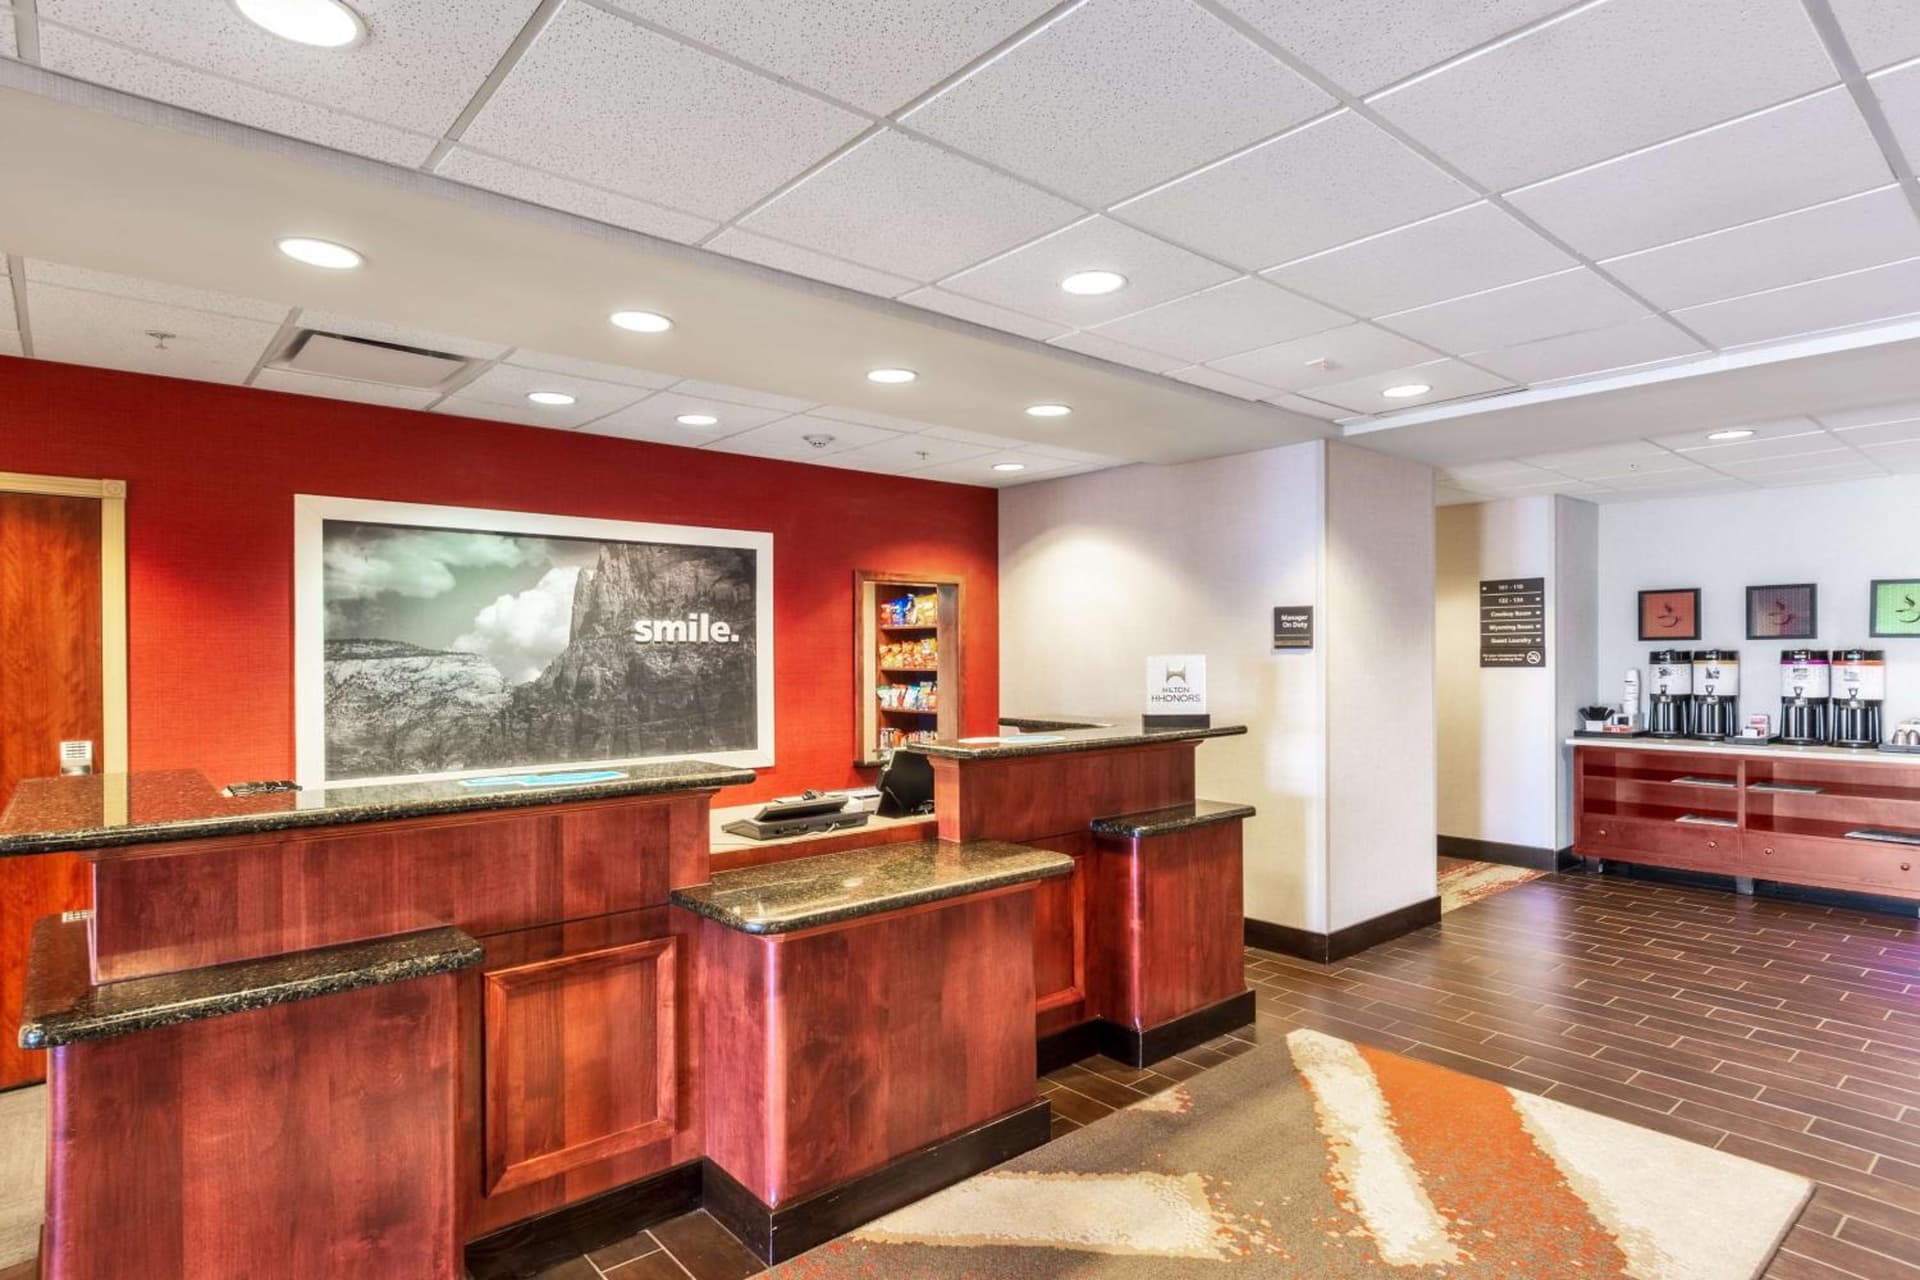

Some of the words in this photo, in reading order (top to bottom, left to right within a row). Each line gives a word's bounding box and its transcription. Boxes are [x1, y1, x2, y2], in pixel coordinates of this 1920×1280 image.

[634, 612, 740, 643] smile.
[1292, 621, 1308, 629] Duty
[1508, 637, 1532, 645] Laundry
